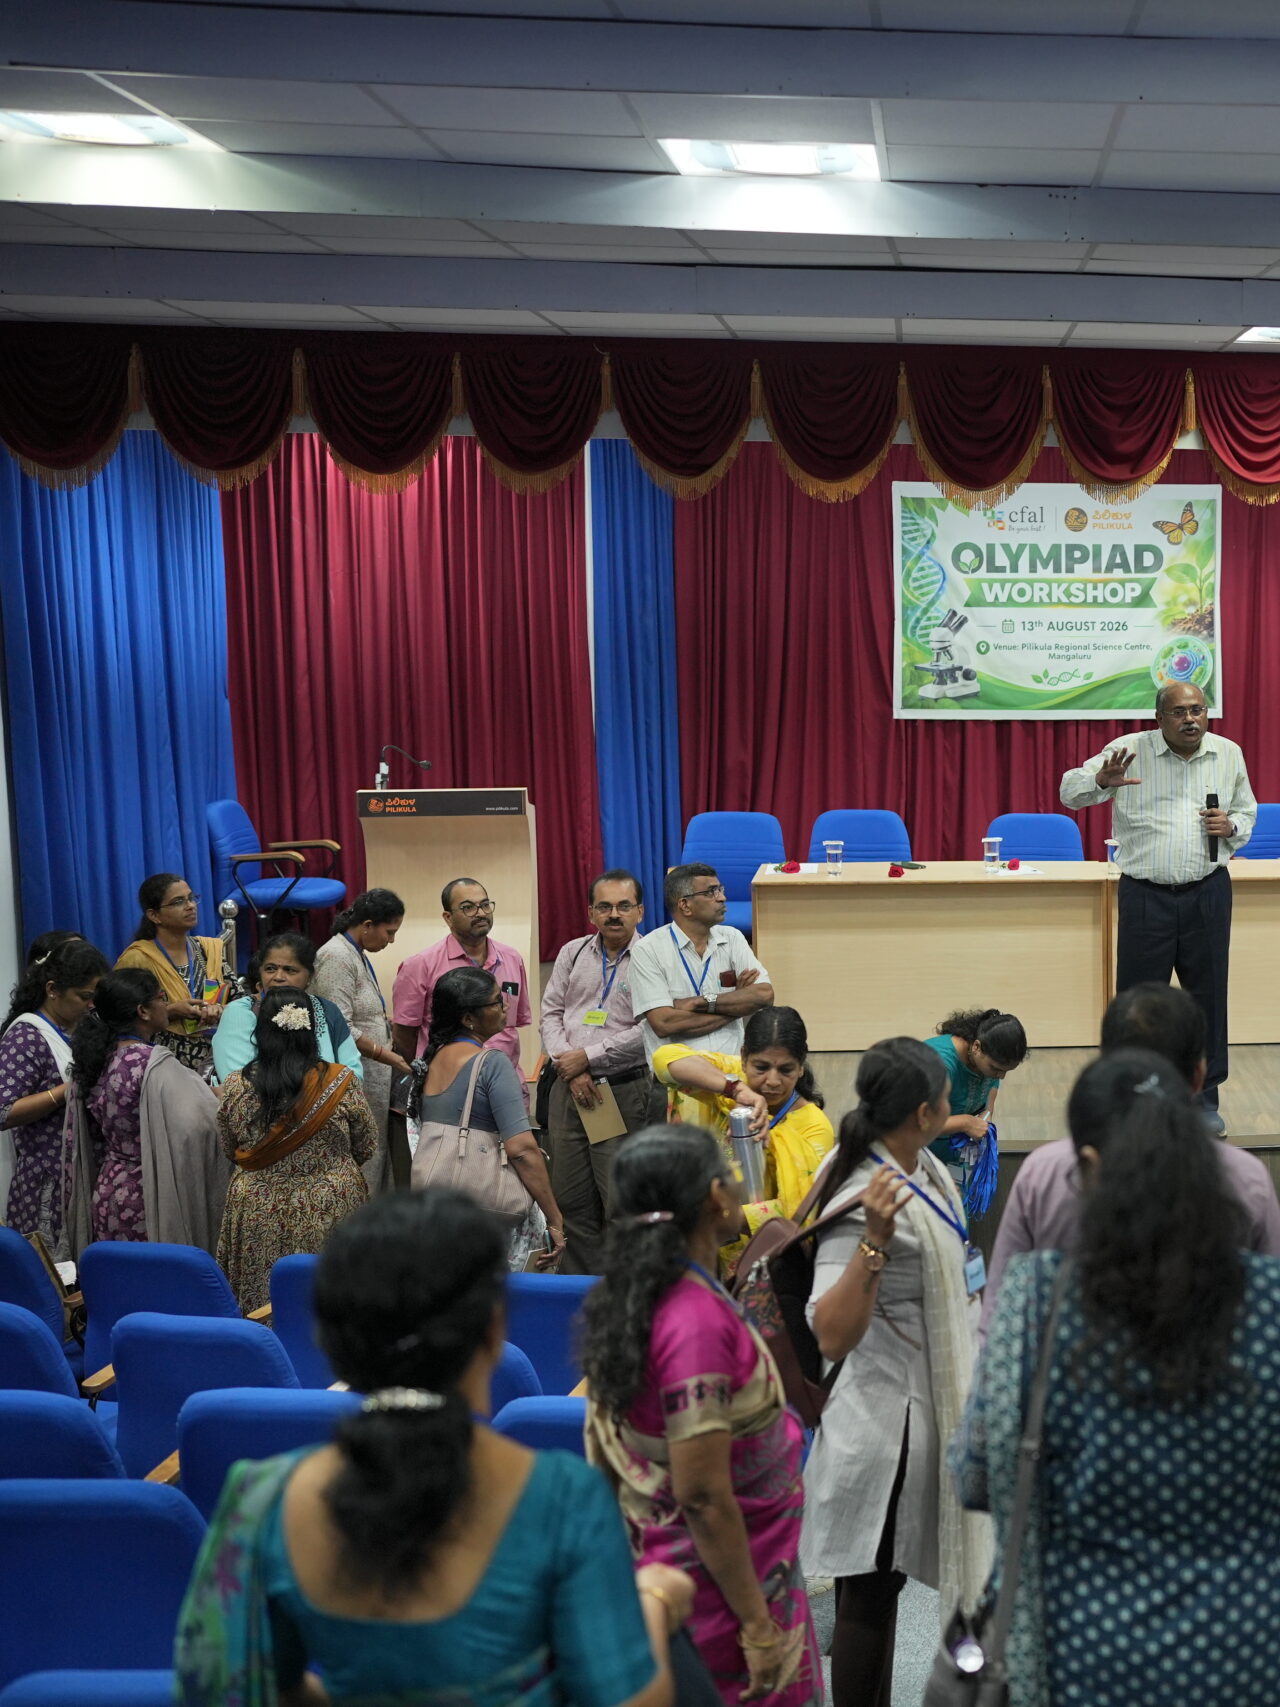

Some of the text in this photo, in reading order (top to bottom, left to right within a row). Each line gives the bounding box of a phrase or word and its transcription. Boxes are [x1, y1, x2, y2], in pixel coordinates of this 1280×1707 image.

[1008, 506, 1044, 523] cfal
[951, 542, 1164, 574] OLYMPIAD
[981, 582, 1142, 603] WORKSHOP
[1021, 621, 1128, 631] 13th AUGUST 2026
[1055, 643, 1090, 653] Regional
[1048, 652, 1092, 661] Mangaluru
